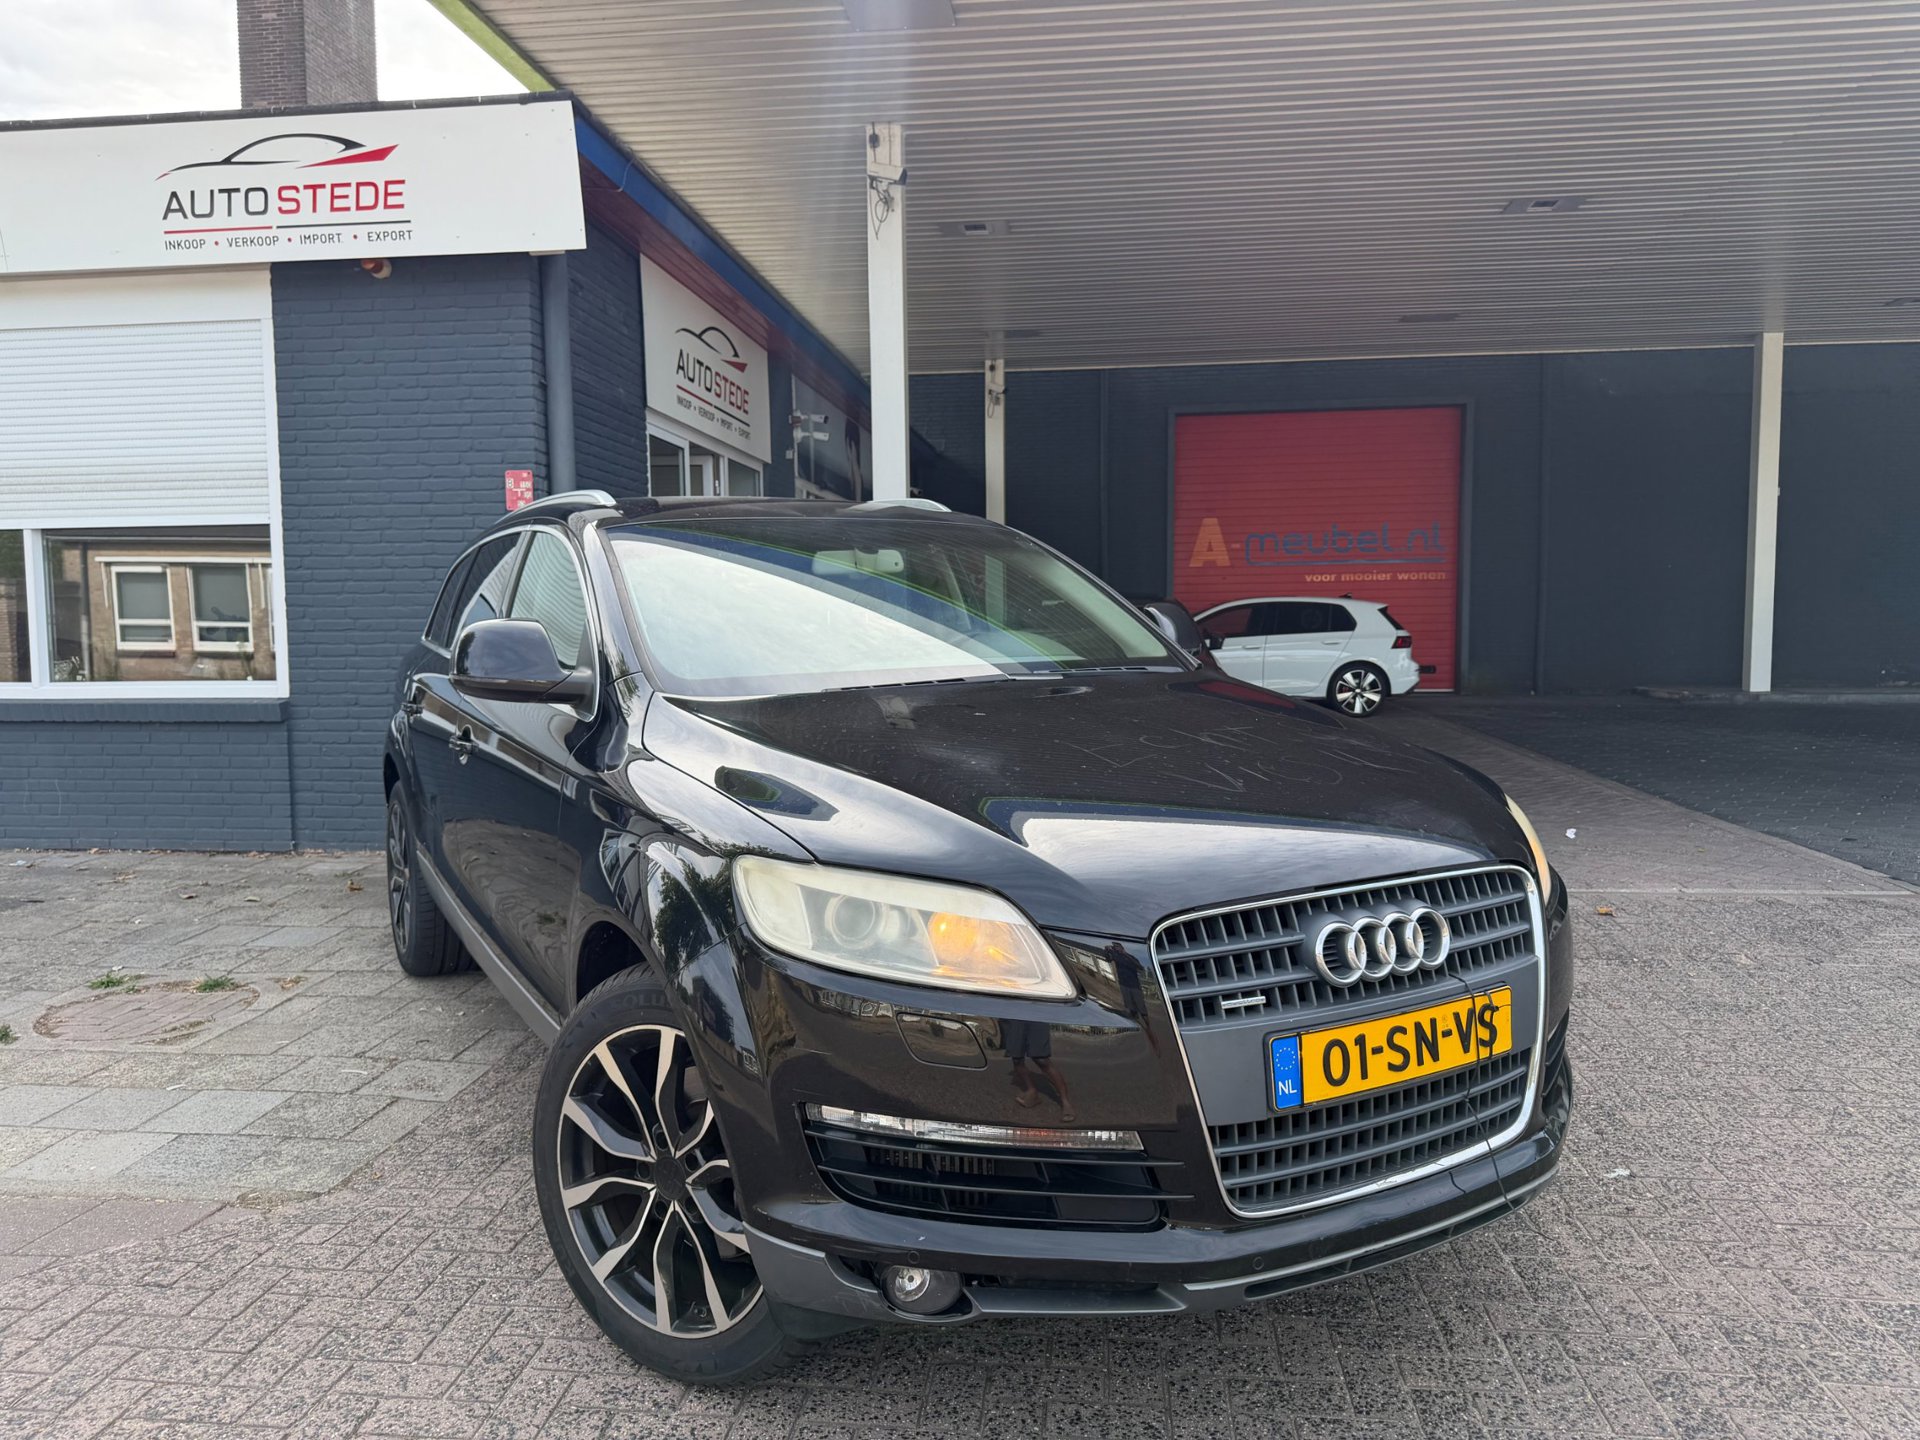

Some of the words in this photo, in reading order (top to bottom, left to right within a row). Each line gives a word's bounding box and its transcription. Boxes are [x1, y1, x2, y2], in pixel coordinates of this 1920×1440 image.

[164, 238, 206, 250] INKOOP
[226, 235, 280, 248] VERKOOP
[299, 233, 342, 246] IMPORT
[366, 230, 413, 242] EXPORT
[1304, 572, 1337, 582] voor
[1341, 570, 1393, 582] mooier
[1397, 571, 1446, 581] wonen
[1322, 1003, 1499, 1087] 01-SN-VS
[1278, 1079, 1297, 1096] NL
